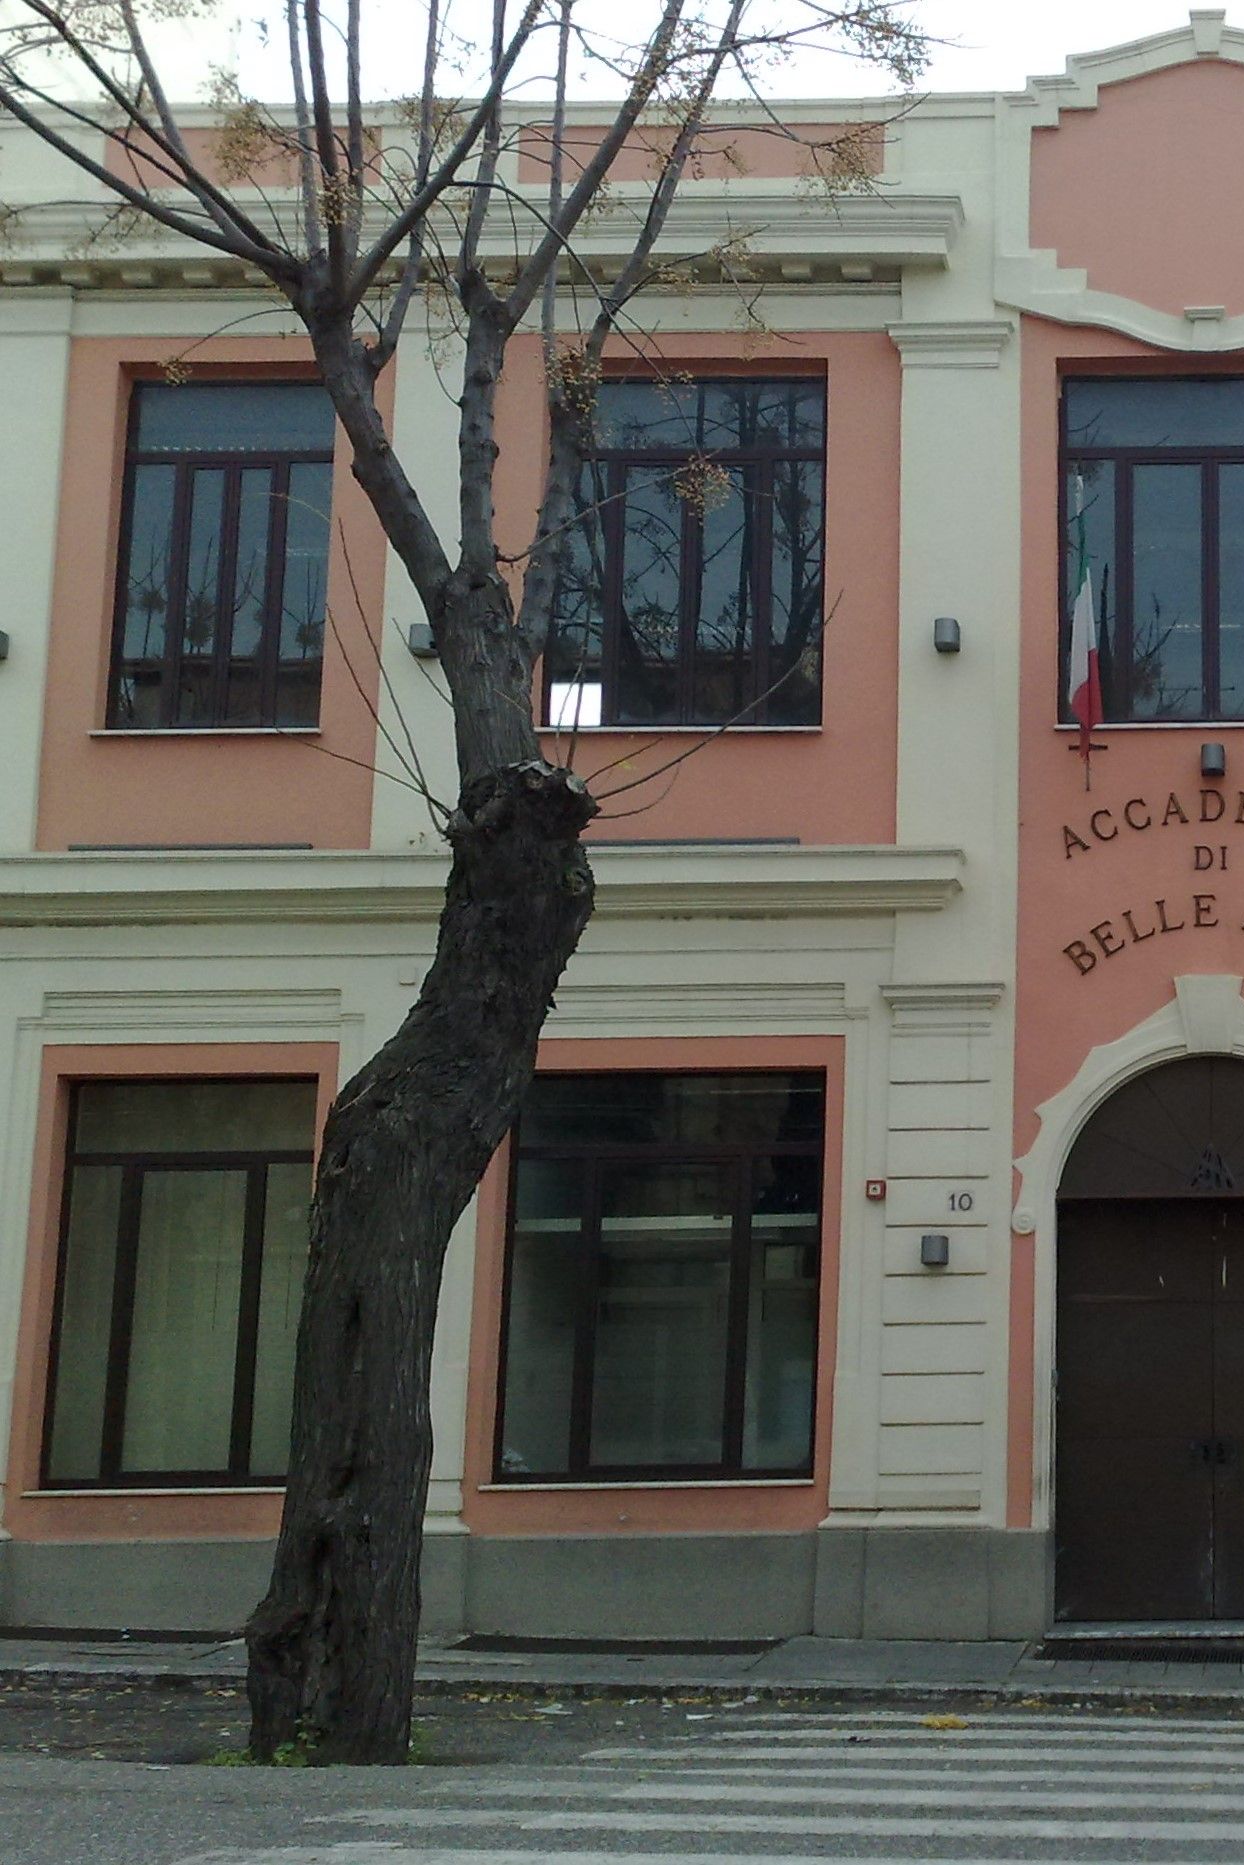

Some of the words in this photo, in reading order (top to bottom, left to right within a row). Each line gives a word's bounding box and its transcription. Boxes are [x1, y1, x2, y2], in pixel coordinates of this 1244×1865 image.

[1193, 845, 1228, 871] DI
[1062, 894, 1220, 976] BELLE
[948, 1193, 973, 1212] 10
